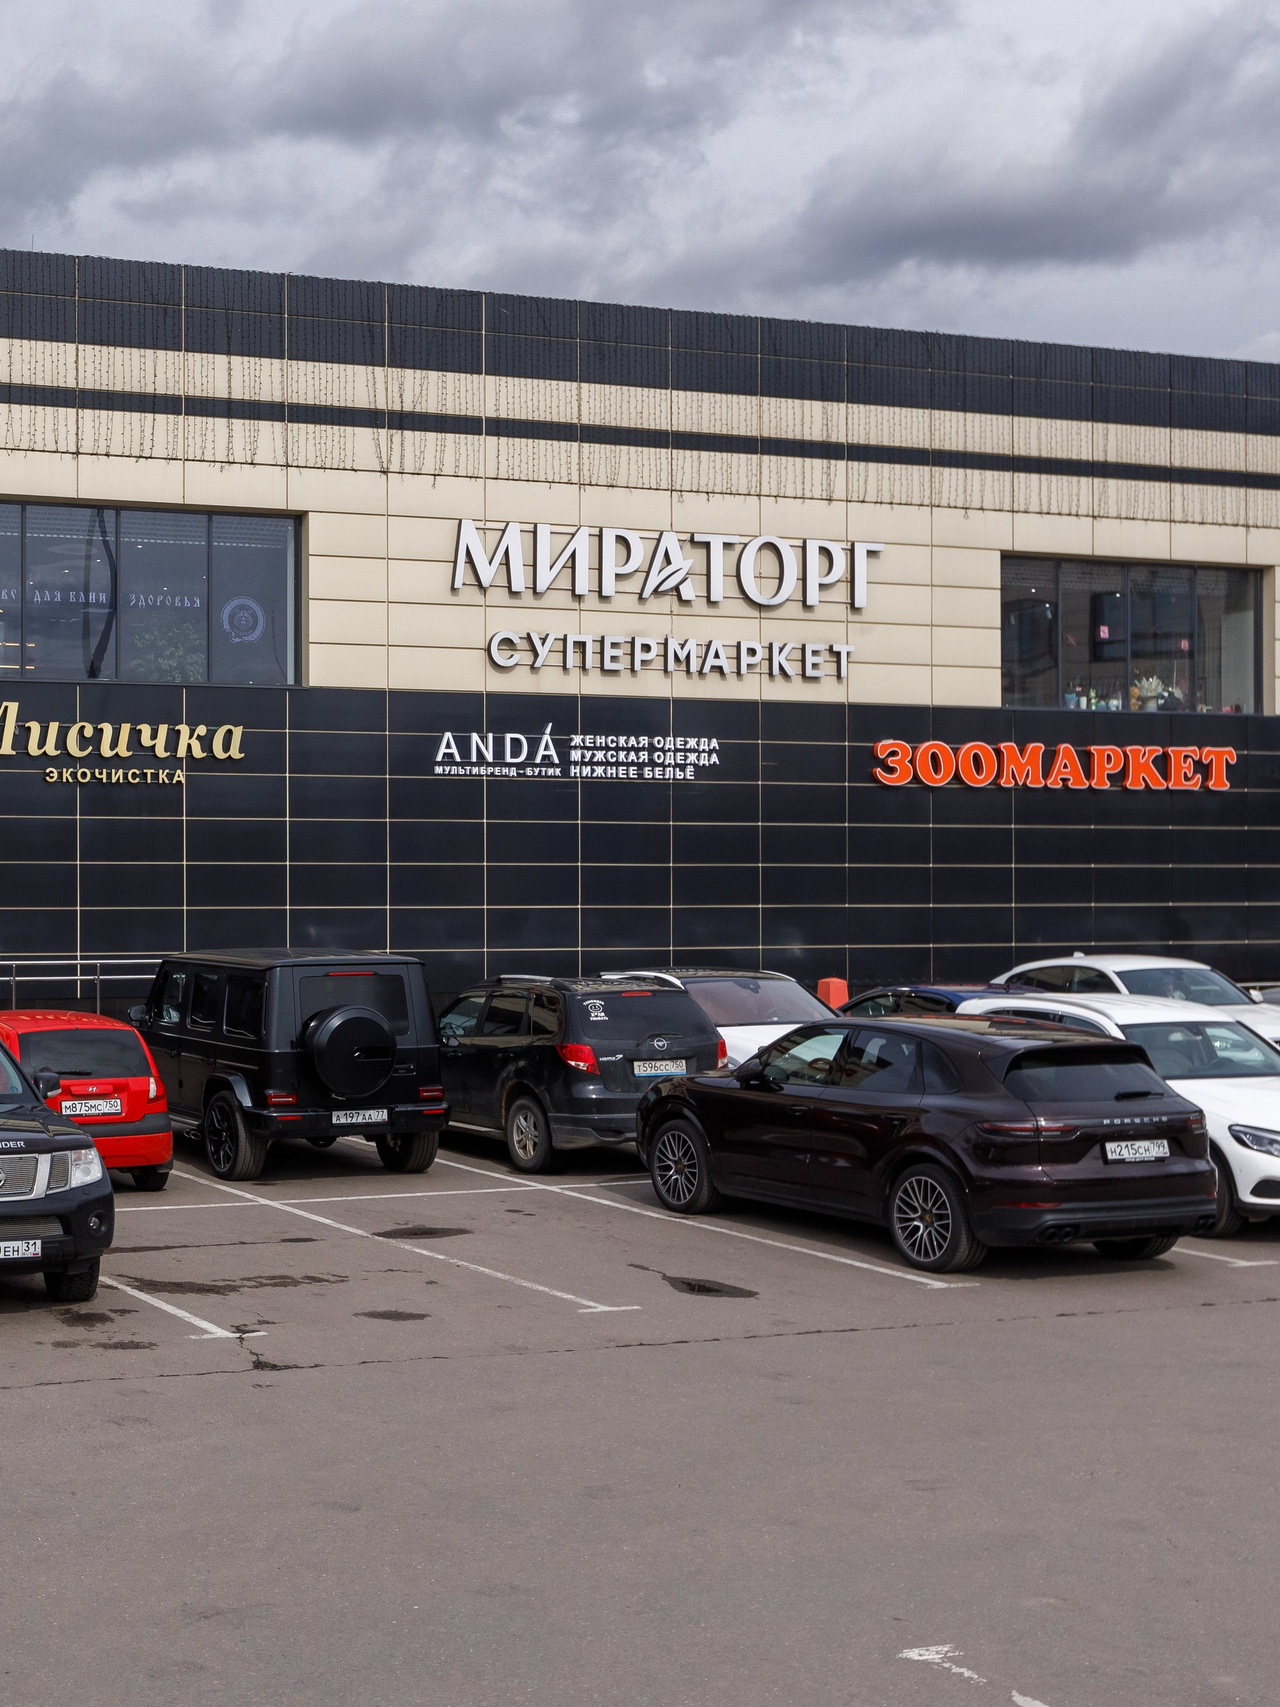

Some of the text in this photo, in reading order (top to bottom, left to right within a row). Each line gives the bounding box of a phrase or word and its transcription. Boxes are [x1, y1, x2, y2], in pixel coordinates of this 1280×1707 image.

[452, 518, 885, 609] МИРАТОРГ
[129, 593, 201, 608] ЗДОРОВЬЯ
[488, 630, 855, 679] СУПЕРМАРКЕТ
[434, 722, 560, 764] ANDÁ
[570, 734, 720, 750] ЖЕНСКАЯ ОДЕЖДА
[570, 750, 720, 766] МУЖСКАЯ ОДЕЖДА
[873, 740, 1237, 791] ЗООМАРКЕТ
[45, 767, 185, 784] ЭКОЧИСТКА
[570, 765, 695, 780] НИЖНЕЕ БЕЛЬЁ
[671, 1060, 684, 1069] 750
[64, 1100, 118, 1114] М875МС 750
[335, 1110, 385, 1123] А197АА 77
[1103, 1116, 1168, 1125] PORSCHE
[1110, 1141, 1165, 1157] Н215СН 799
[23, 1241, 37, 1252] 31
